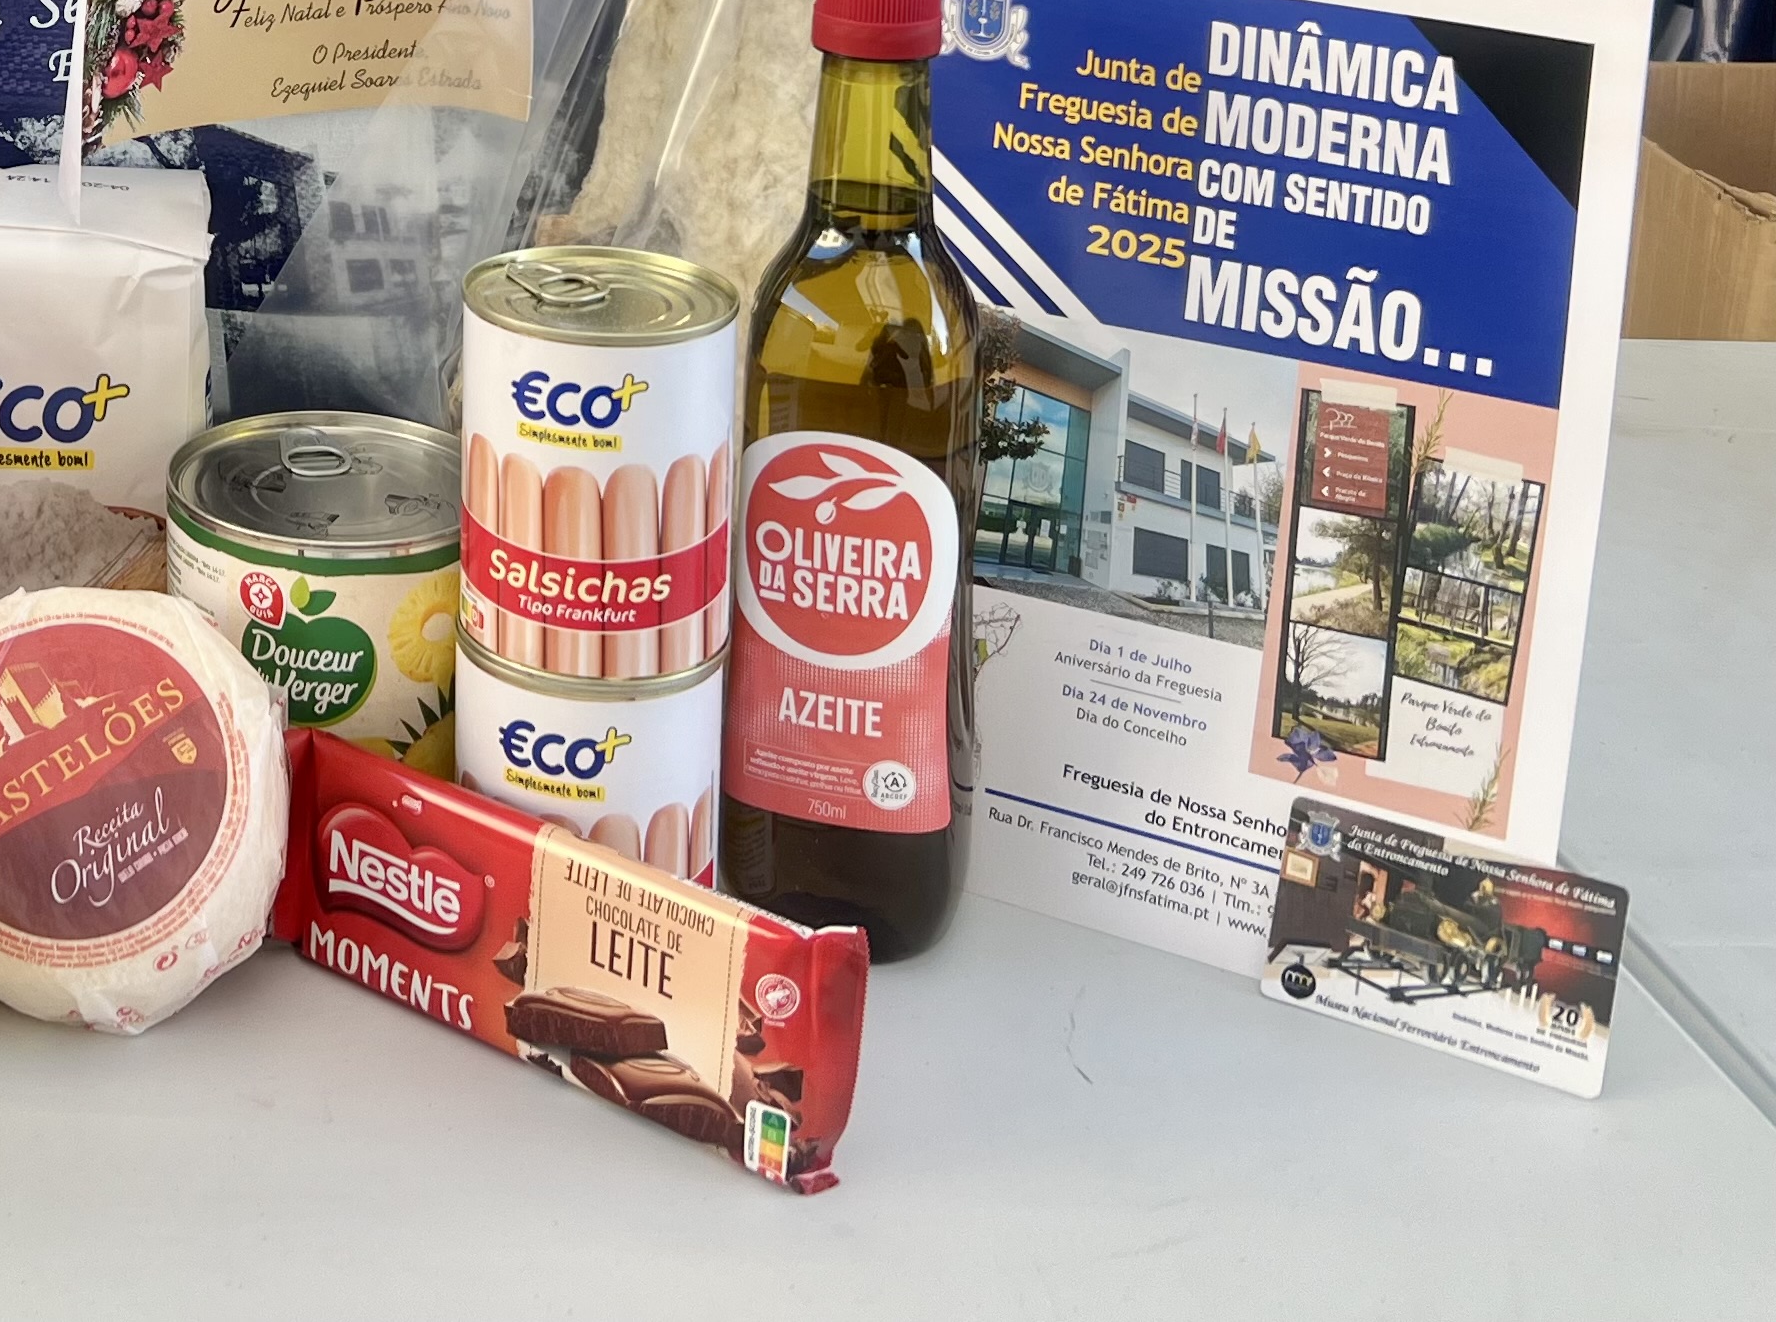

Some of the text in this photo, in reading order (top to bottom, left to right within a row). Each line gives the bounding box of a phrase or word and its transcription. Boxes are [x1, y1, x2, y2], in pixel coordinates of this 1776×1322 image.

[1076, 49, 1202, 93] Junta de
[1208, 21, 1460, 115] DINÂMICA
[1018, 82, 1198, 137] Freguesia de
[992, 122, 1193, 180] Nossa Senhora
[1204, 91, 1454, 186] MODERNA
[1048, 176, 1189, 224] de Fátima
[1197, 158, 1431, 236] COM SENTIDO
[1086, 224, 1186, 267] 2025
[1192, 206, 1237, 250] DE
[1184, 254, 1493, 377] MISSÃO...
[519, 423, 588, 448] Simplesmente
[489, 548, 672, 602] Salsichas
[755, 520, 921, 581] OLIVEIRA
[243, 574, 276, 593] MARCA
[518, 593, 636, 623] Tipo Frankfurt
[759, 559, 908, 621] DA SERRA
[249, 605, 274, 619] GUIA
[251, 628, 364, 672] Douceur
[1054, 650, 1223, 702] Aniversário da Freguesia
[1089, 639, 1192, 674] Dia 1 de Julho
[273, 671, 358, 714] Verger
[778, 687, 883, 738] AZEITE
[1062, 684, 1208, 731] Dia 24 de Novembro
[1076, 708, 1187, 747] Dia do Concelho
[807, 798, 847, 819] 750ml
[1062, 764, 1227, 822] Freguesia de Nossa
[1145, 809, 1167, 827] do
[51, 786, 170, 906] Original
[73, 799, 143, 855] Receita
[988, 807, 1013, 826] Rua
[1017, 814, 1035, 830] Dr.
[1040, 821, 1103, 850] Francisco
[1107, 840, 1159, 866] Mendes
[1163, 852, 1181, 870] de
[1185, 857, 1225, 886] Brito,
[1252, 880, 1270, 898] 3A
[329, 831, 461, 923] Nestlé
[565, 858, 715, 937] CHOCOLATE DE LEITE
[1072, 871, 1210, 922] geral@jfnsfatima.pt
[1086, 853, 1263, 916] Tel.: 249 726 036 Tlm.:
[585, 895, 683, 953] CHOCOLATE DE
[309, 921, 473, 1032] MOMENTS
[589, 923, 675, 1000] LEITE
